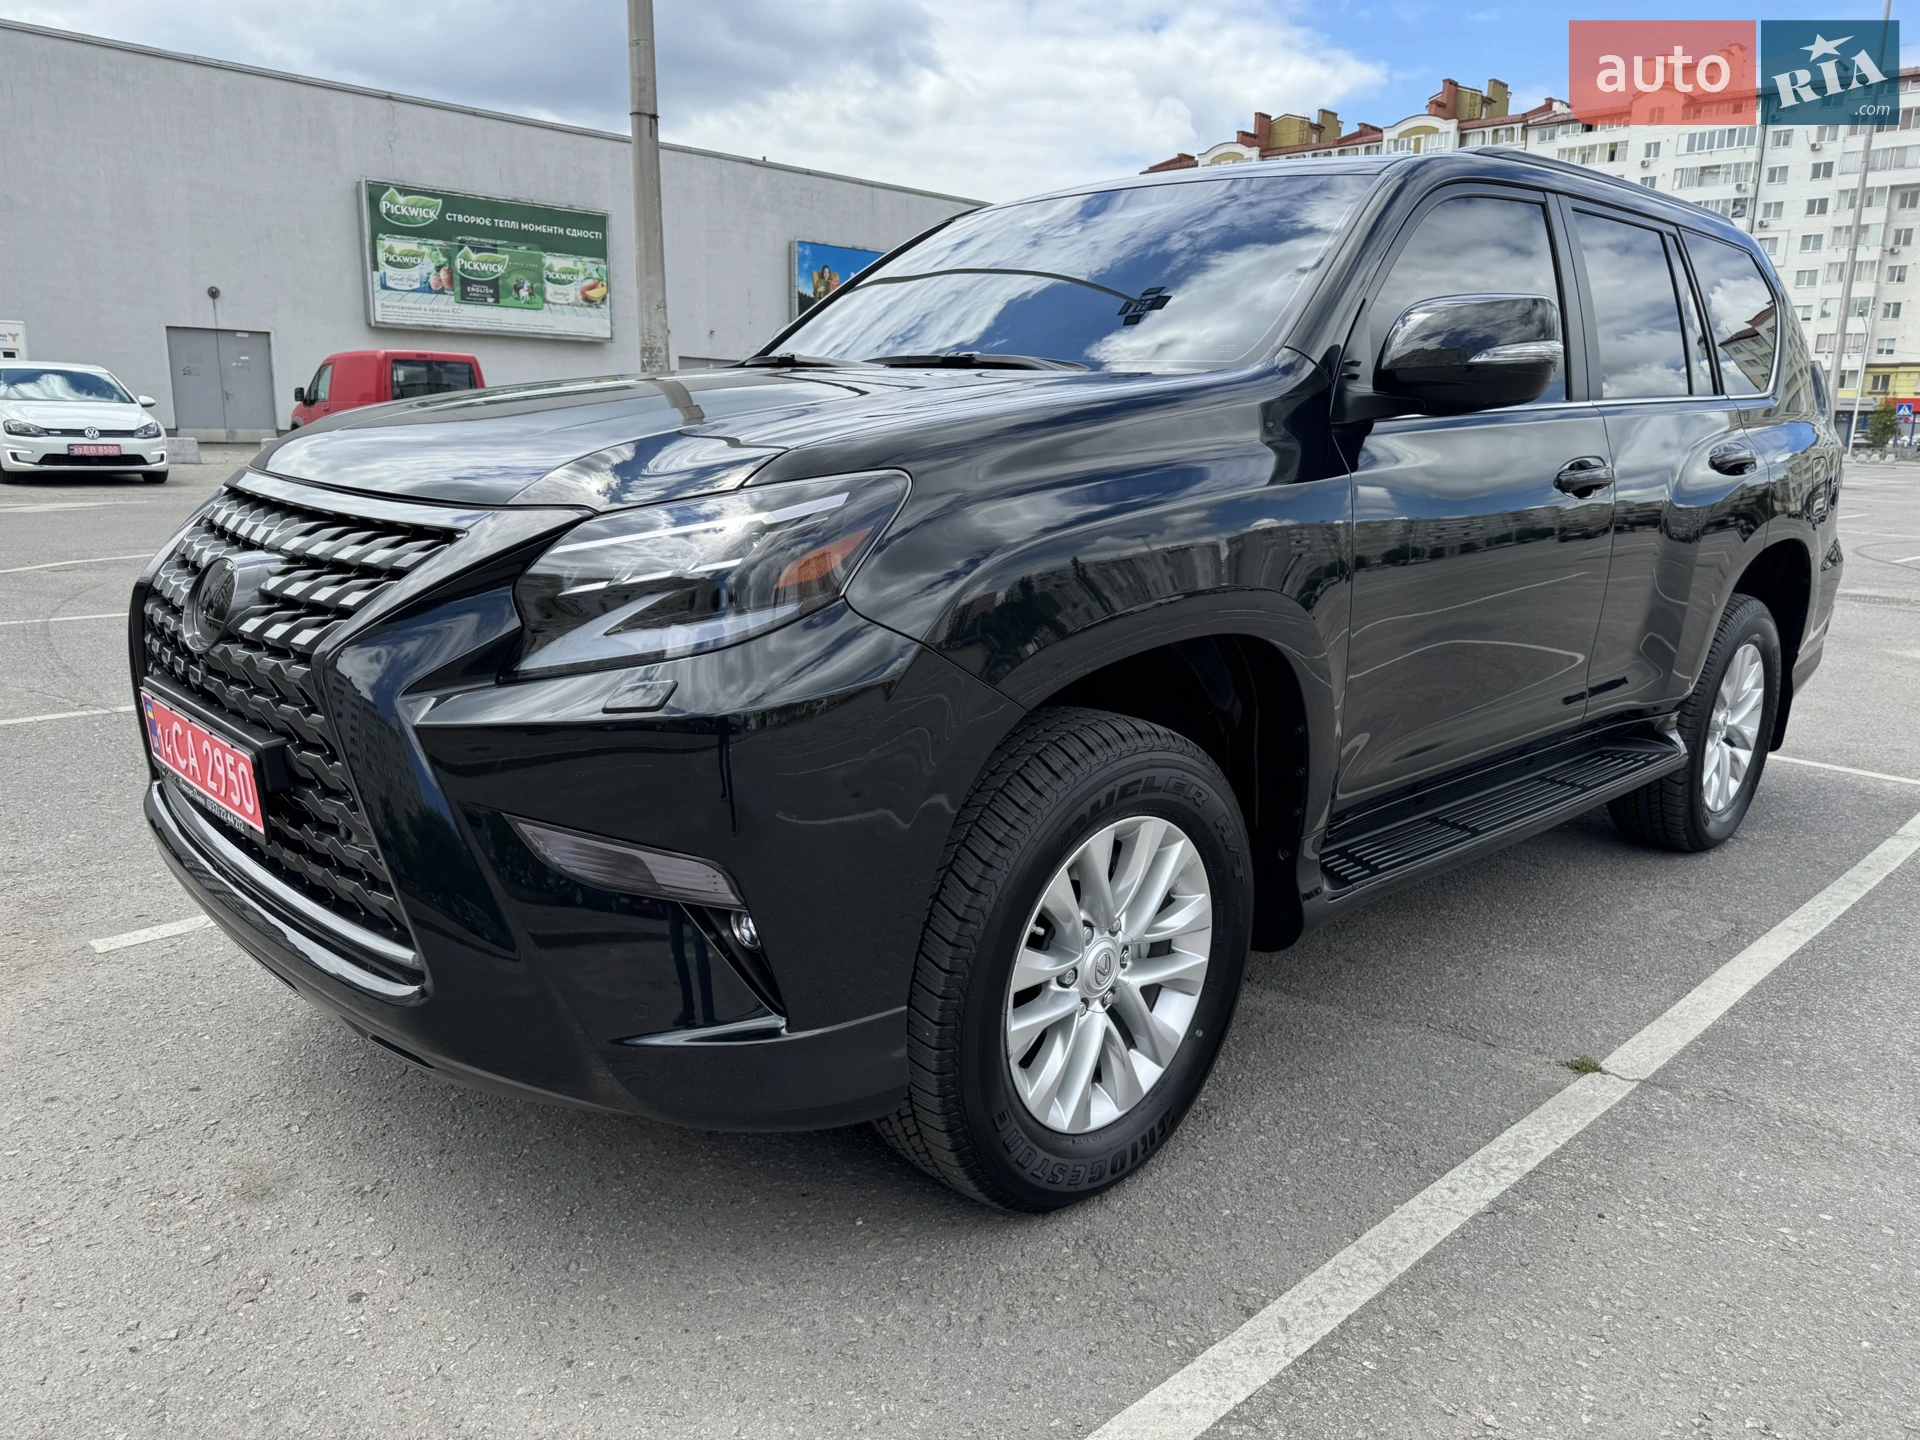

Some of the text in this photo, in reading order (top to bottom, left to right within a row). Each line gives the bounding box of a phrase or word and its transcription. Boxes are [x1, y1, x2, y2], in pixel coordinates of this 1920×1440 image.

[381, 199, 438, 220] PICKWICK
[446, 212, 603, 240] СТВОРЮЄ ТЕПЛІ МОМЕНТИ ЄДНОСТІ
[382, 252, 424, 266] PICKWICK
[456, 257, 506, 274] PICKWICK
[202, 740, 255, 815] 2950
[1062, 775, 1210, 850] DUELER
[992, 1105, 1176, 1187] BRIDGESTONE
